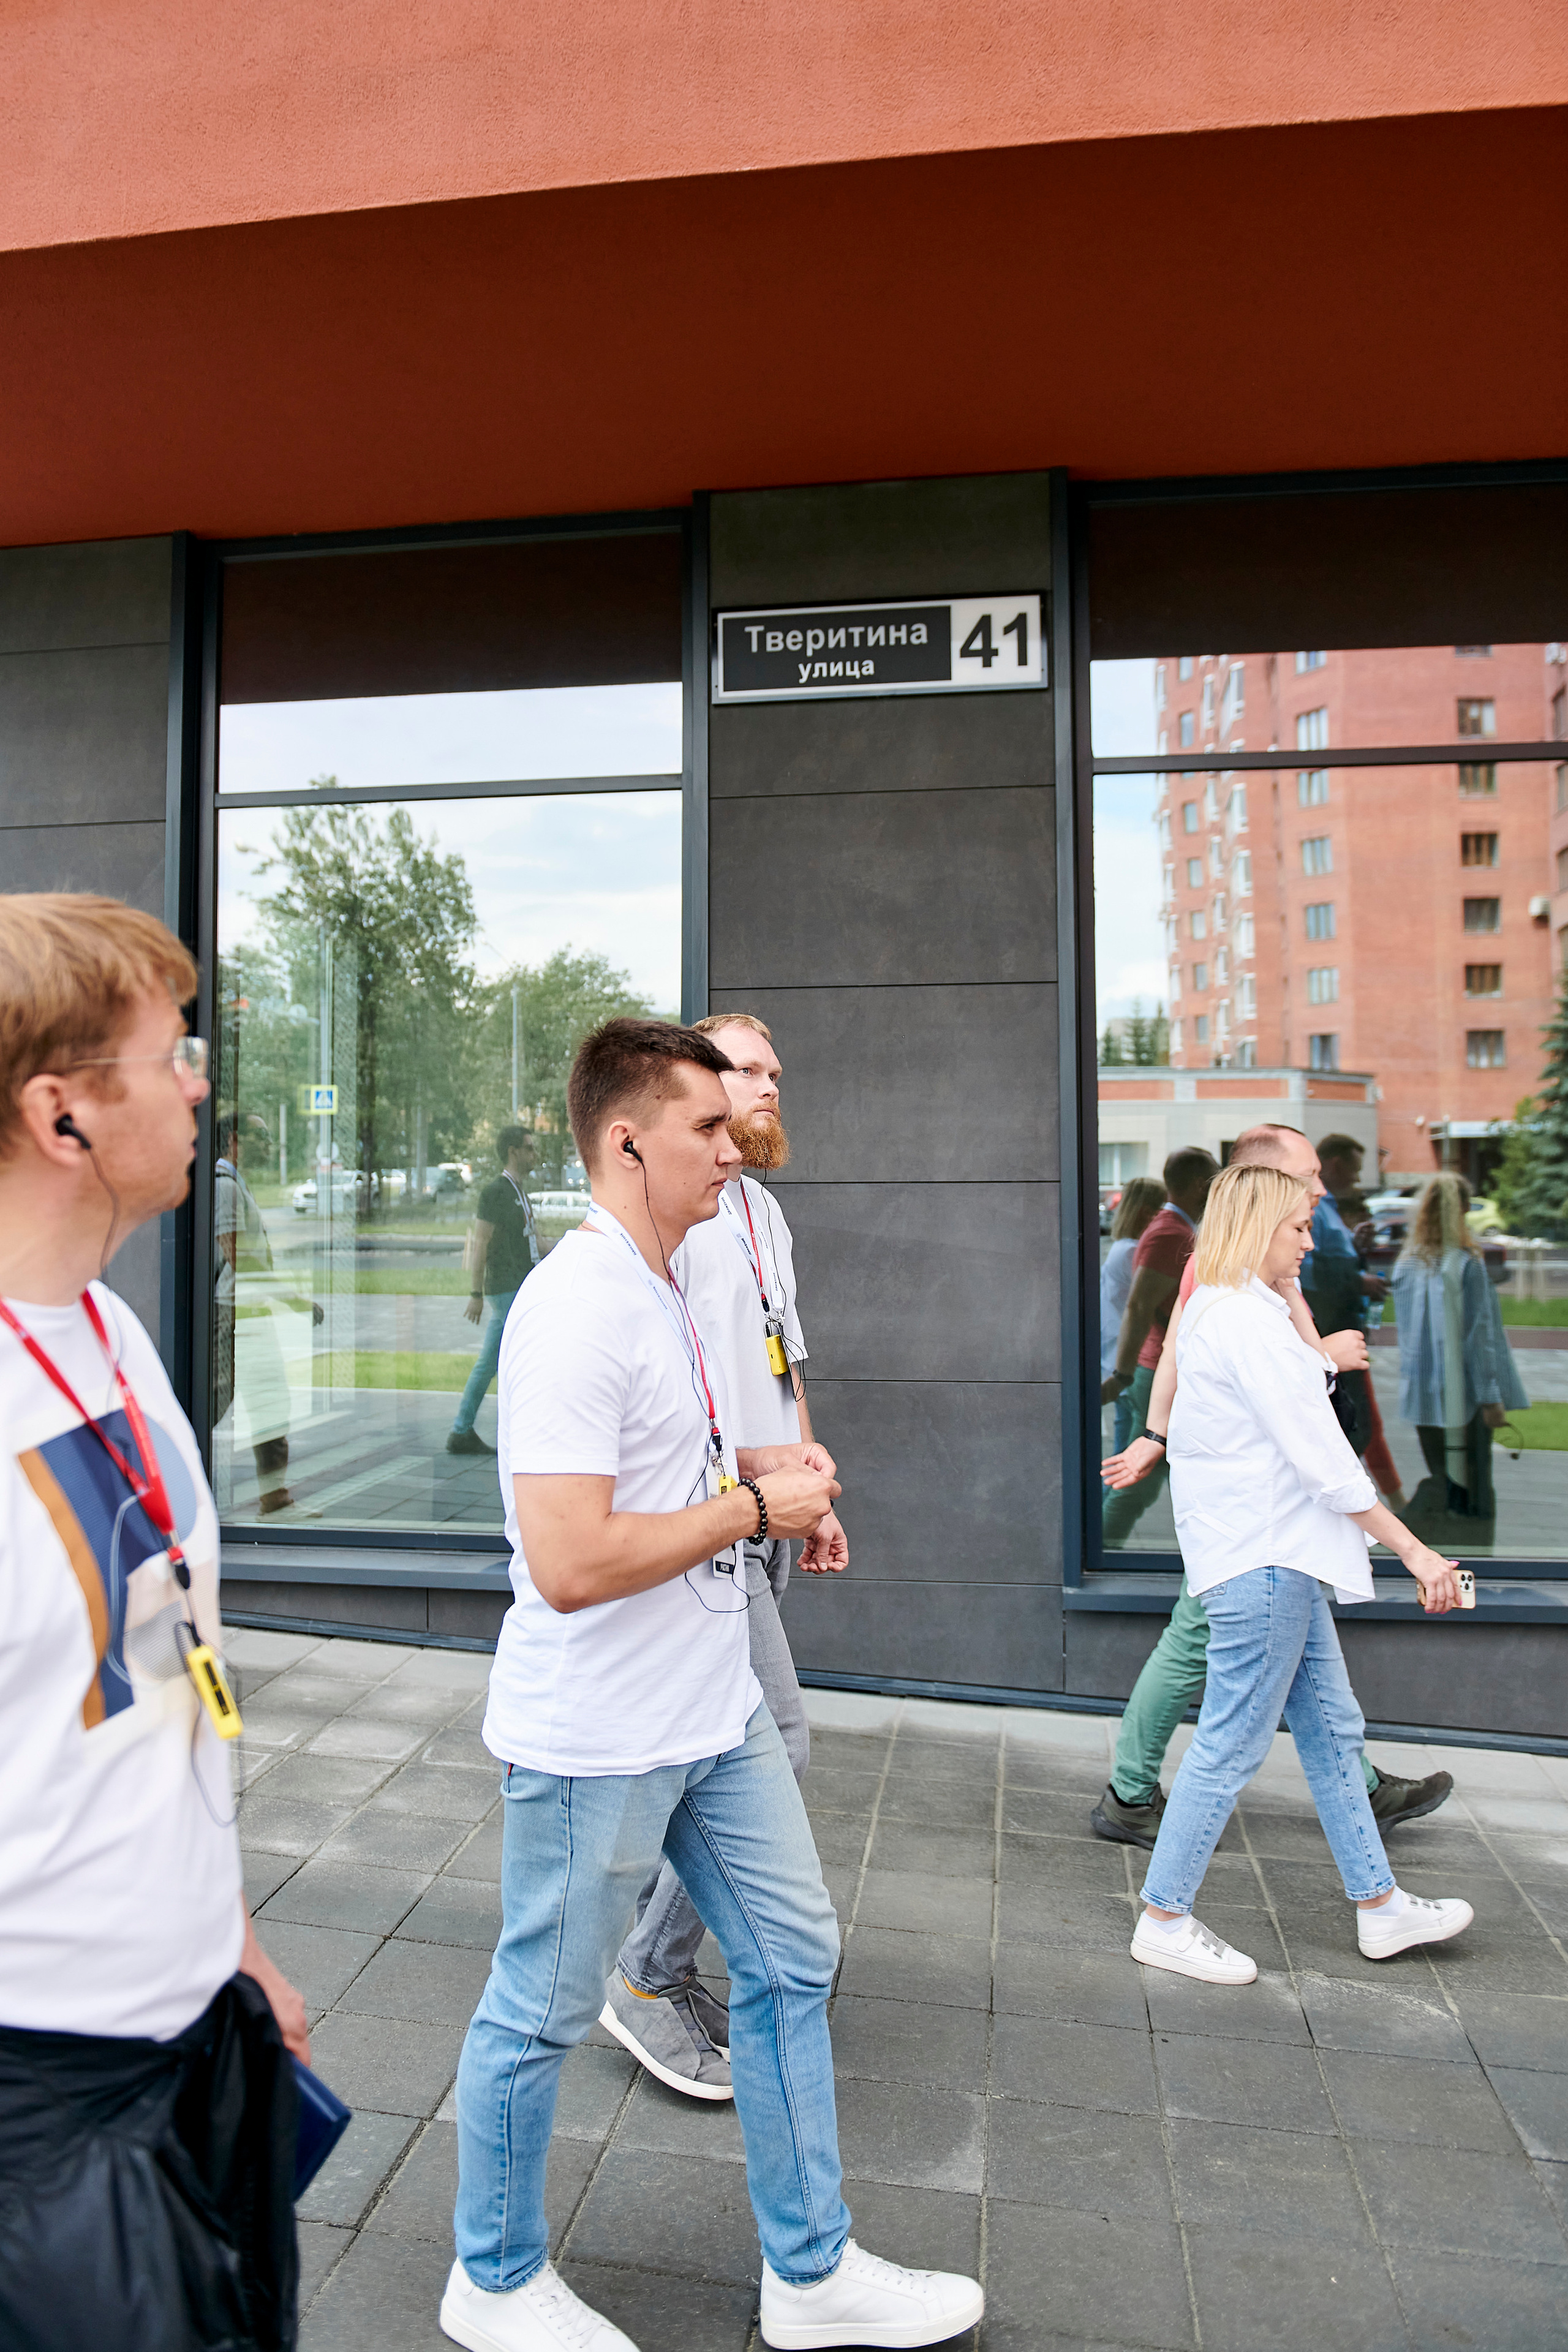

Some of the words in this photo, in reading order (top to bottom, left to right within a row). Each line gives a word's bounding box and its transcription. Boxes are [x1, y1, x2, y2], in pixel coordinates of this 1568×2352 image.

[744, 622, 928, 657] Тверитина
[959, 612, 1028, 668] 41
[798, 658, 875, 684] улица
